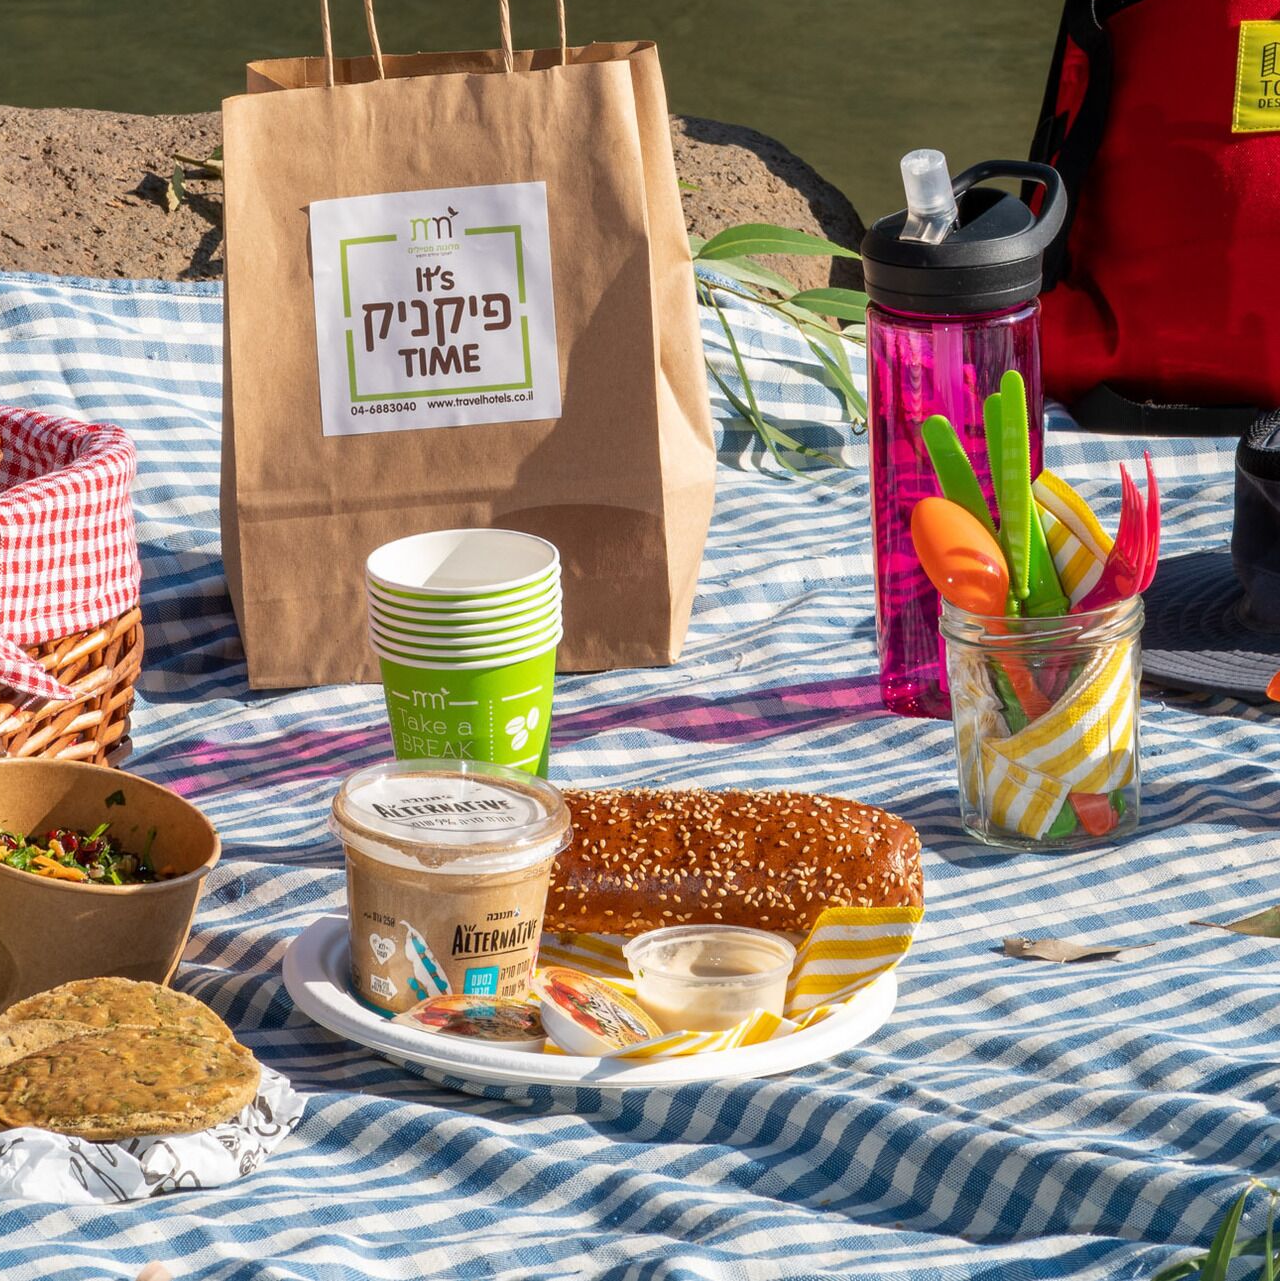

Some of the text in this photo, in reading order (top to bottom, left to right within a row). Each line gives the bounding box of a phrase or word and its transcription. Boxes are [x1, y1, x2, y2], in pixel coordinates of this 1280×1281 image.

[362, 293, 512, 352] פיקניק
[398, 343, 481, 378] TIME
[351, 390, 534, 416] 04-6883040 www.travelhotels.co.il
[398, 707, 473, 736] Take a
[402, 734, 474, 759] BREAK
[486, 910, 513, 921] תנובה
[471, 973, 493, 987] בטעם
